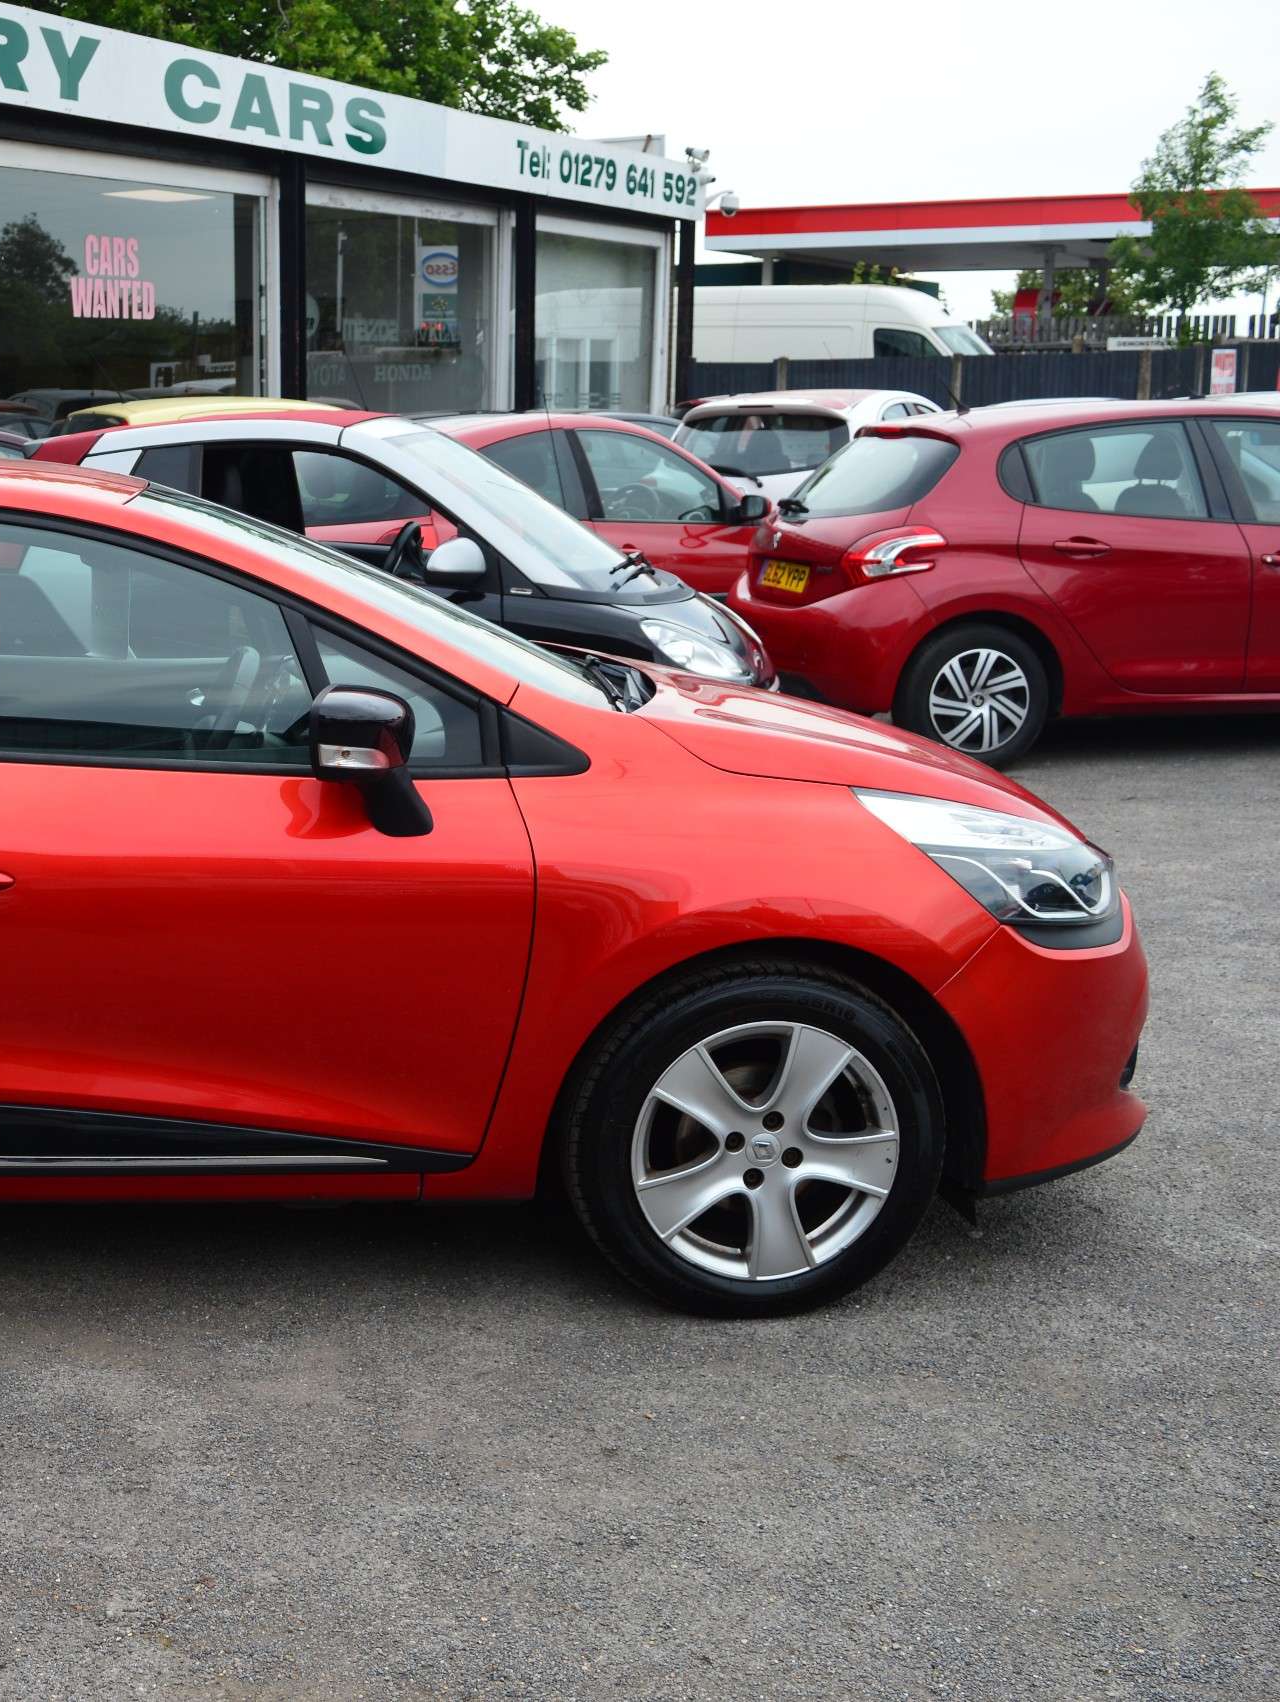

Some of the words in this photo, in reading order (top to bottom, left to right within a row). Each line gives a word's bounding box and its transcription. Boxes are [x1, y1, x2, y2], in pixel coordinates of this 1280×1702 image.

[164, 58, 387, 155] CARS
[517, 139, 551, 180] Tel:
[559, 149, 617, 191] 01279
[626, 163, 656, 198] 641
[663, 171, 697, 206] 592
[85, 234, 139, 278] CARS
[70, 276, 155, 320] WANTED
[307, 363, 347, 385] YOTA
[372, 363, 432, 382] HONDA
